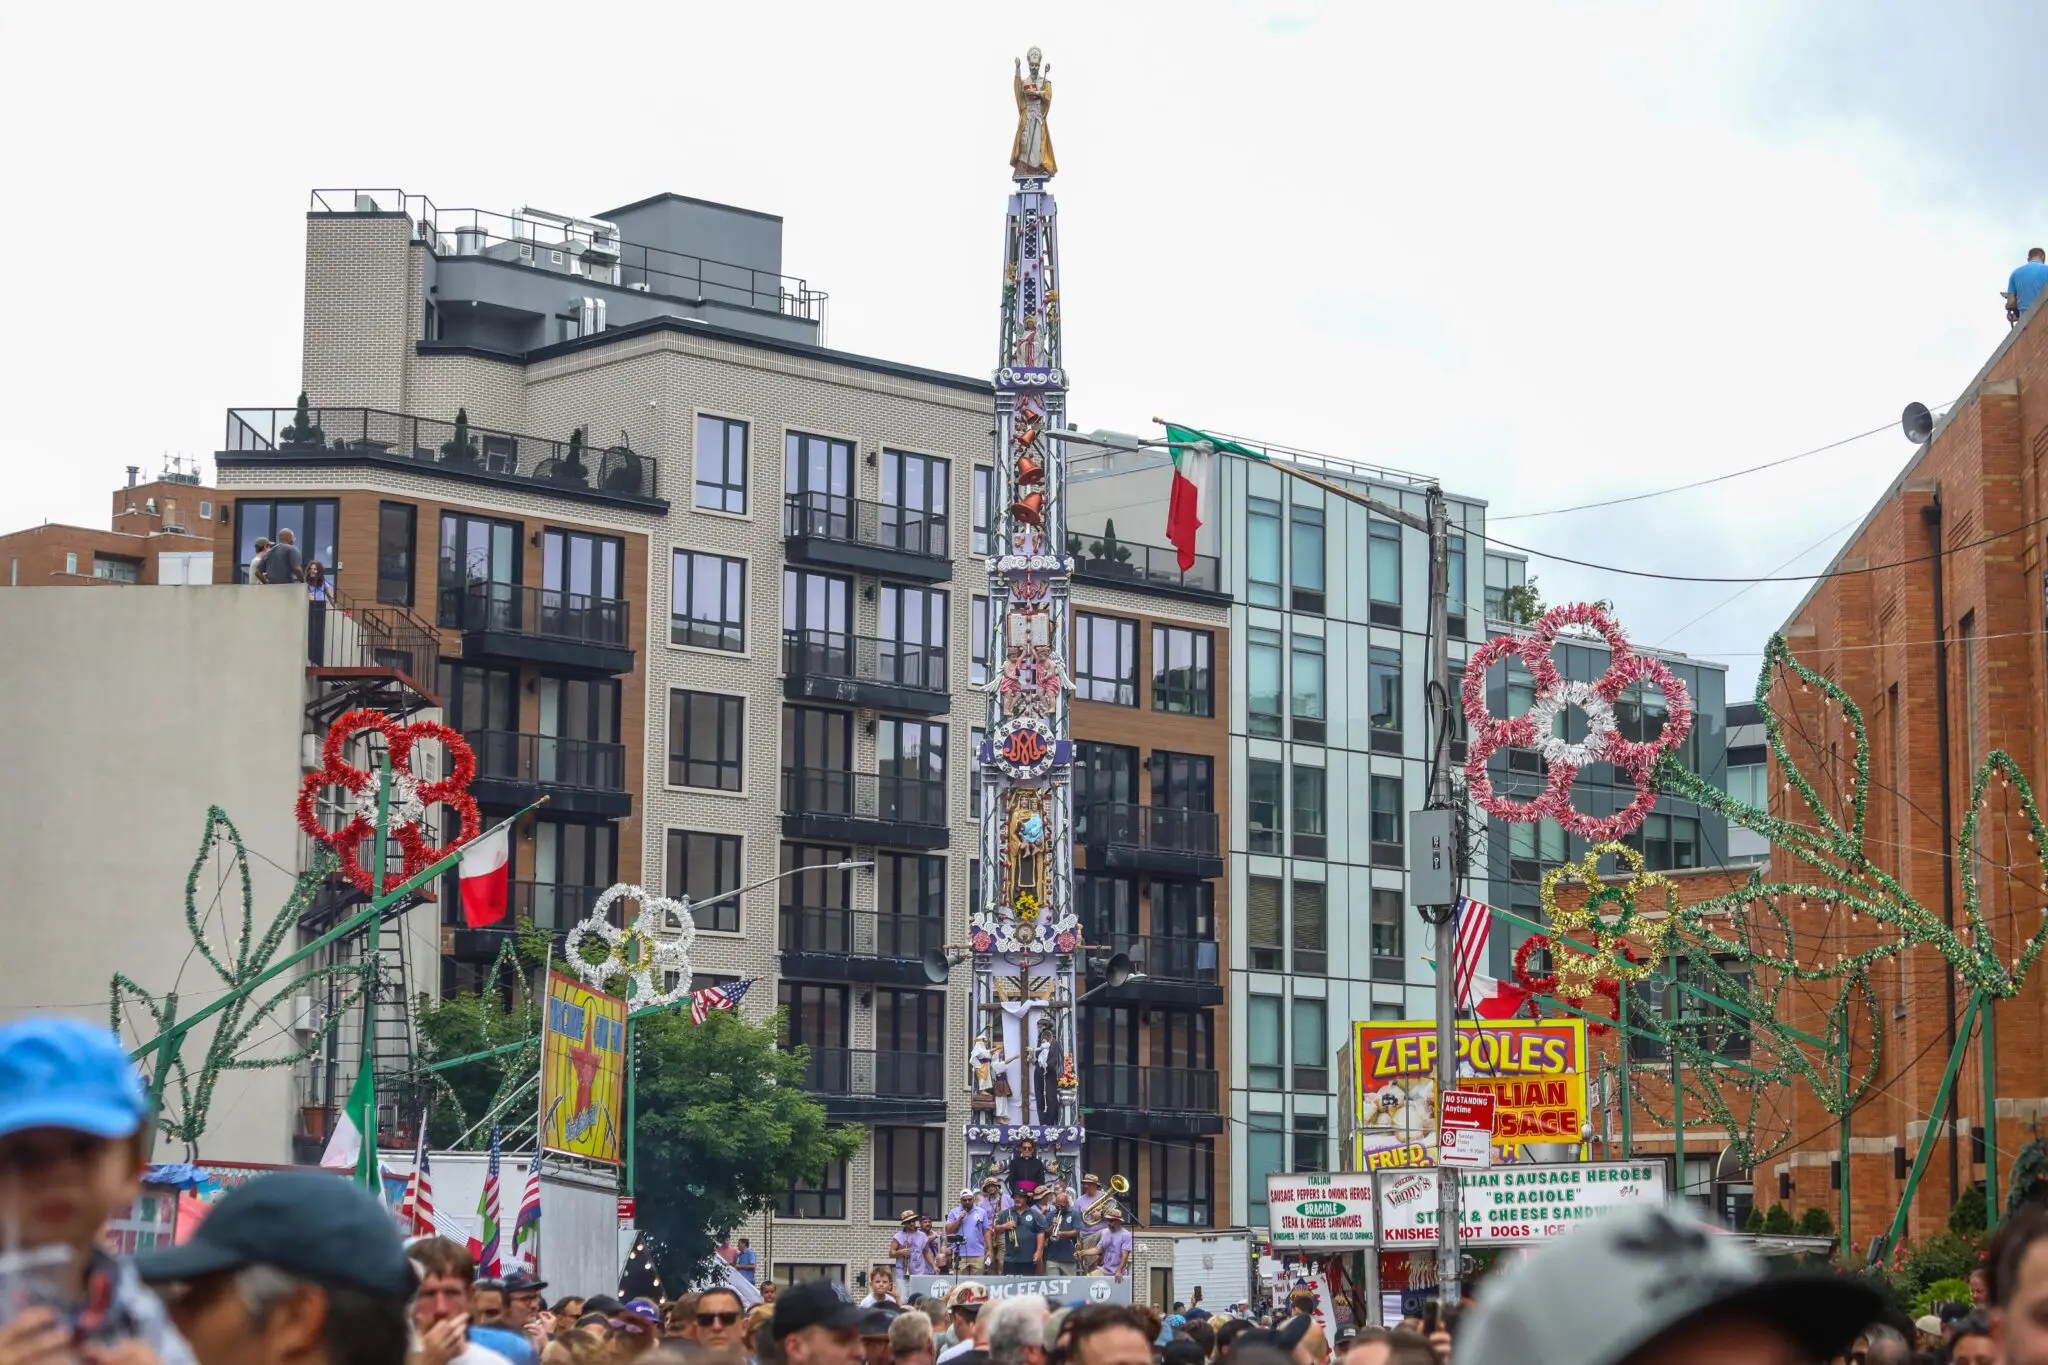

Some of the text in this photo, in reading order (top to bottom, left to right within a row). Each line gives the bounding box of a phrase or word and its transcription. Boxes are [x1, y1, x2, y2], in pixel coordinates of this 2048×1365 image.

[1446, 1095, 1488, 1106] NO STANDING
[1445, 1105, 1472, 1114] Anytime
[1368, 1145, 1424, 1170] FRIED
[1307, 1176, 1331, 1186] ITALIAN
[1504, 1170, 1581, 1187] SAUSAGE
[1587, 1168, 1653, 1182] HEROES
[1296, 1188, 1320, 1200] PEPPERS
[1328, 1188, 1348, 1200] ONIONS
[1349, 1186, 1371, 1201] HEROES
[1304, 1202, 1338, 1216] BRACIOLE
[1471, 1210, 1482, 1222] &
[1488, 1207, 1549, 1222] CHEESE
[1282, 1215, 1298, 1229] STEAK
[1306, 1217, 1326, 1229] CHEESE
[1328, 1214, 1362, 1228] SANDWICHES
[1273, 1232, 1295, 1240] KNISHES
[1298, 1232, 1309, 1240] HOT
[1311, 1232, 1326, 1240] DOGS
[1339, 1231, 1353, 1240] COLD
[1354, 1231, 1374, 1240] DRINKS
[1384, 1228, 1439, 1241] KNISHES
[1490, 1224, 1530, 1238] DOGS
[990, 1284, 1016, 1300] MC
[1020, 1280, 1071, 1296] FEAST
